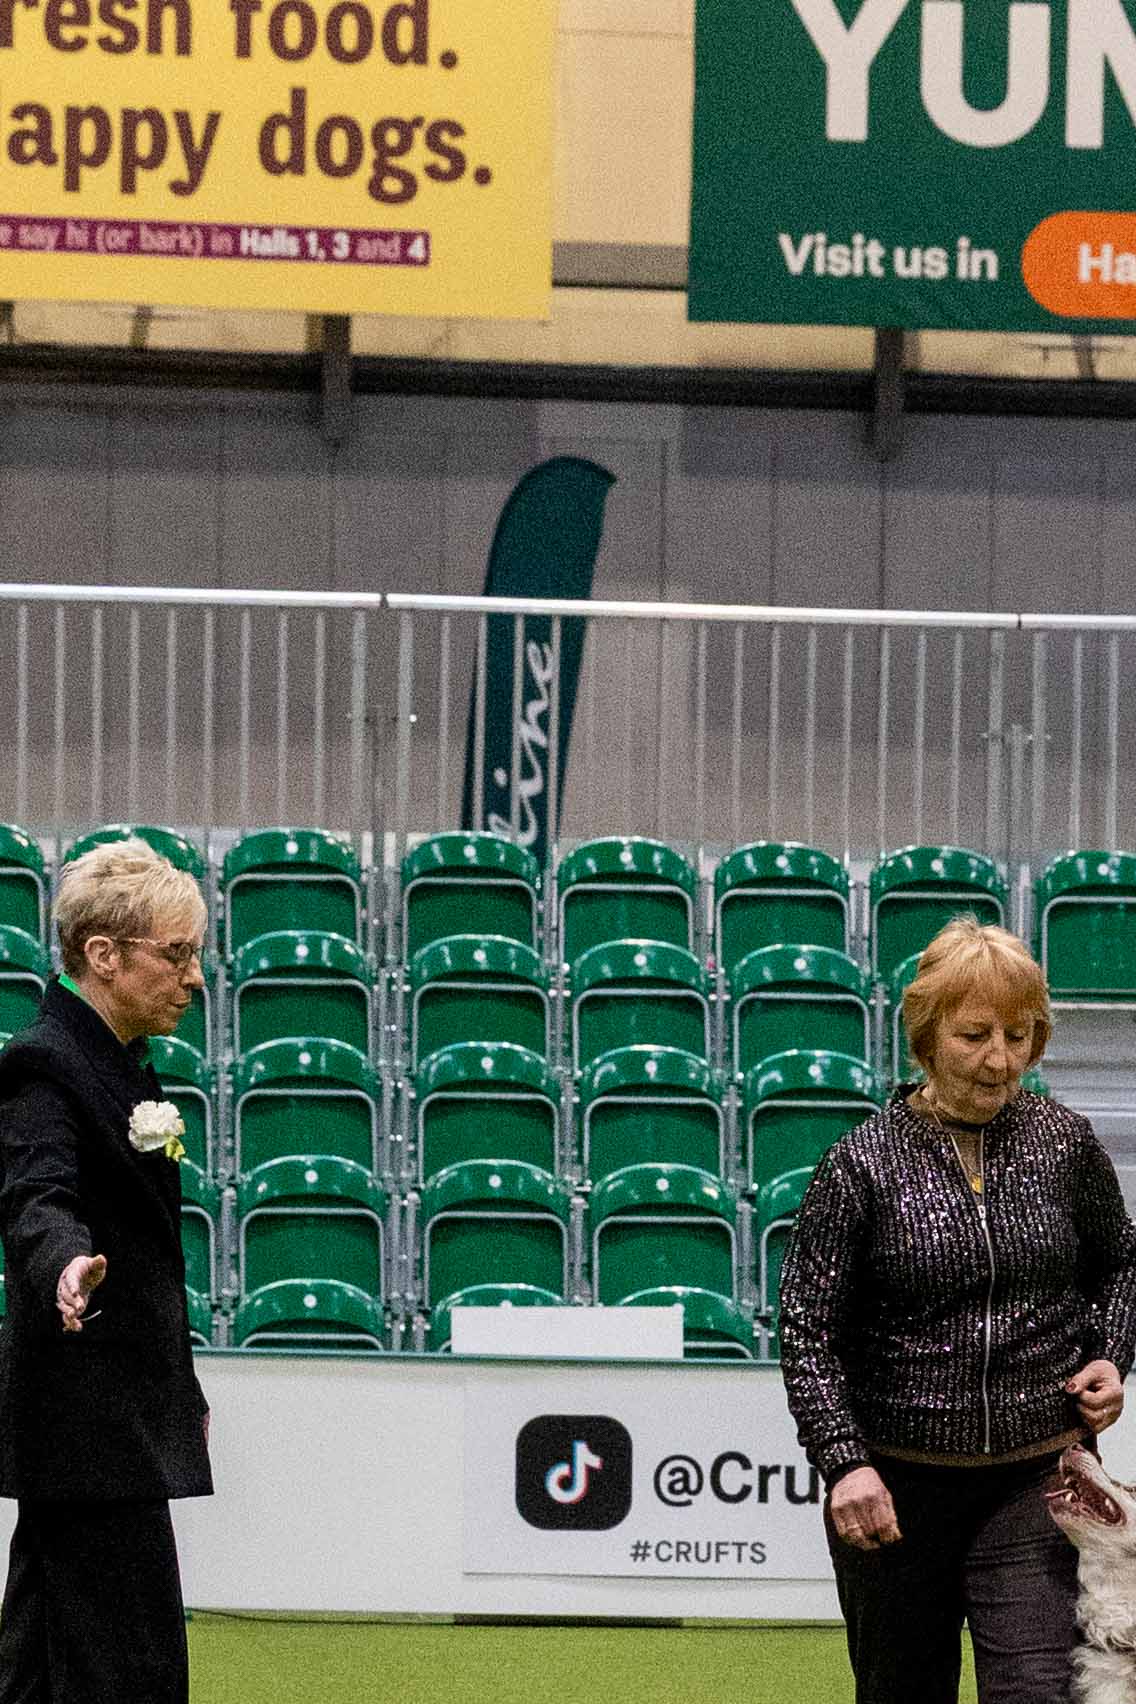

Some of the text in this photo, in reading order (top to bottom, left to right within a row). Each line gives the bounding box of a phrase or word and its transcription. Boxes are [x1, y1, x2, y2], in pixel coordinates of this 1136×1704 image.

[230, 0, 458, 69] food.
[7, 86, 493, 206] appy dogs.
[240, 227, 300, 257] Halls
[306, 229, 326, 261] 1,
[332, 230, 350, 259] 3
[356, 232, 400, 260] and
[407, 233, 427, 260] 4
[778, 232, 999, 280] Visit us in
[630, 1539, 767, 1565] #CRUFTS
